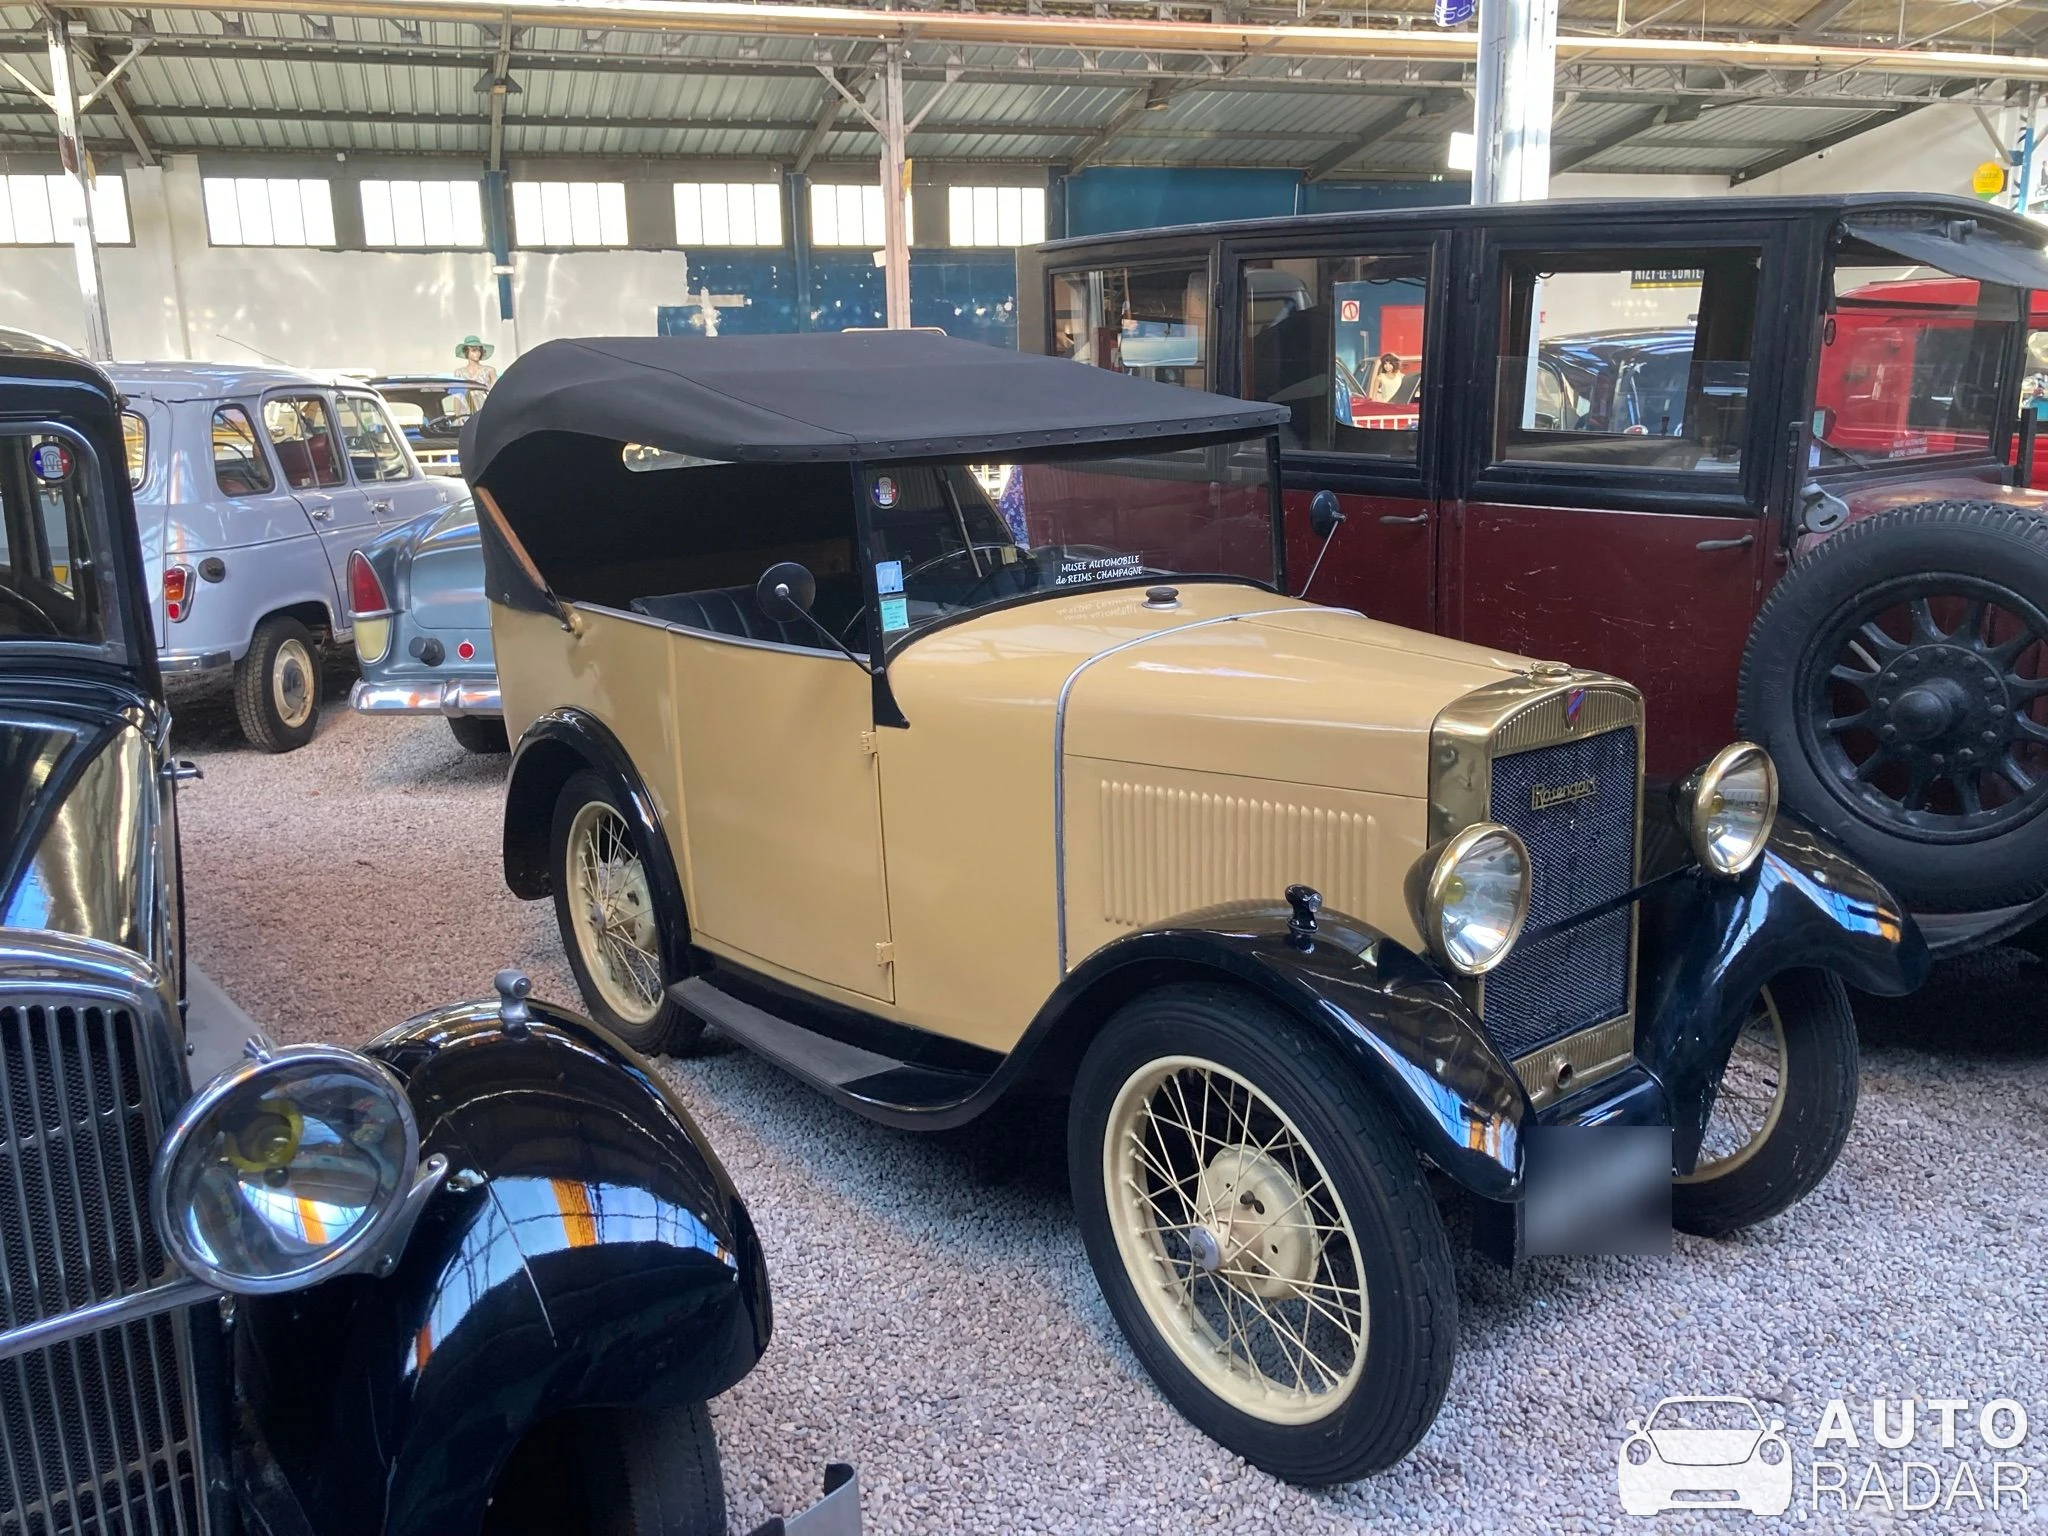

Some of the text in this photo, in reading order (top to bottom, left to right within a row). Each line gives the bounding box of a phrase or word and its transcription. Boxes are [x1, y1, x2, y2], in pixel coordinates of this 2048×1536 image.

[1061, 555, 1140, 573] MUSEE AUTOMOBILE
[1056, 575, 1067, 584] de
